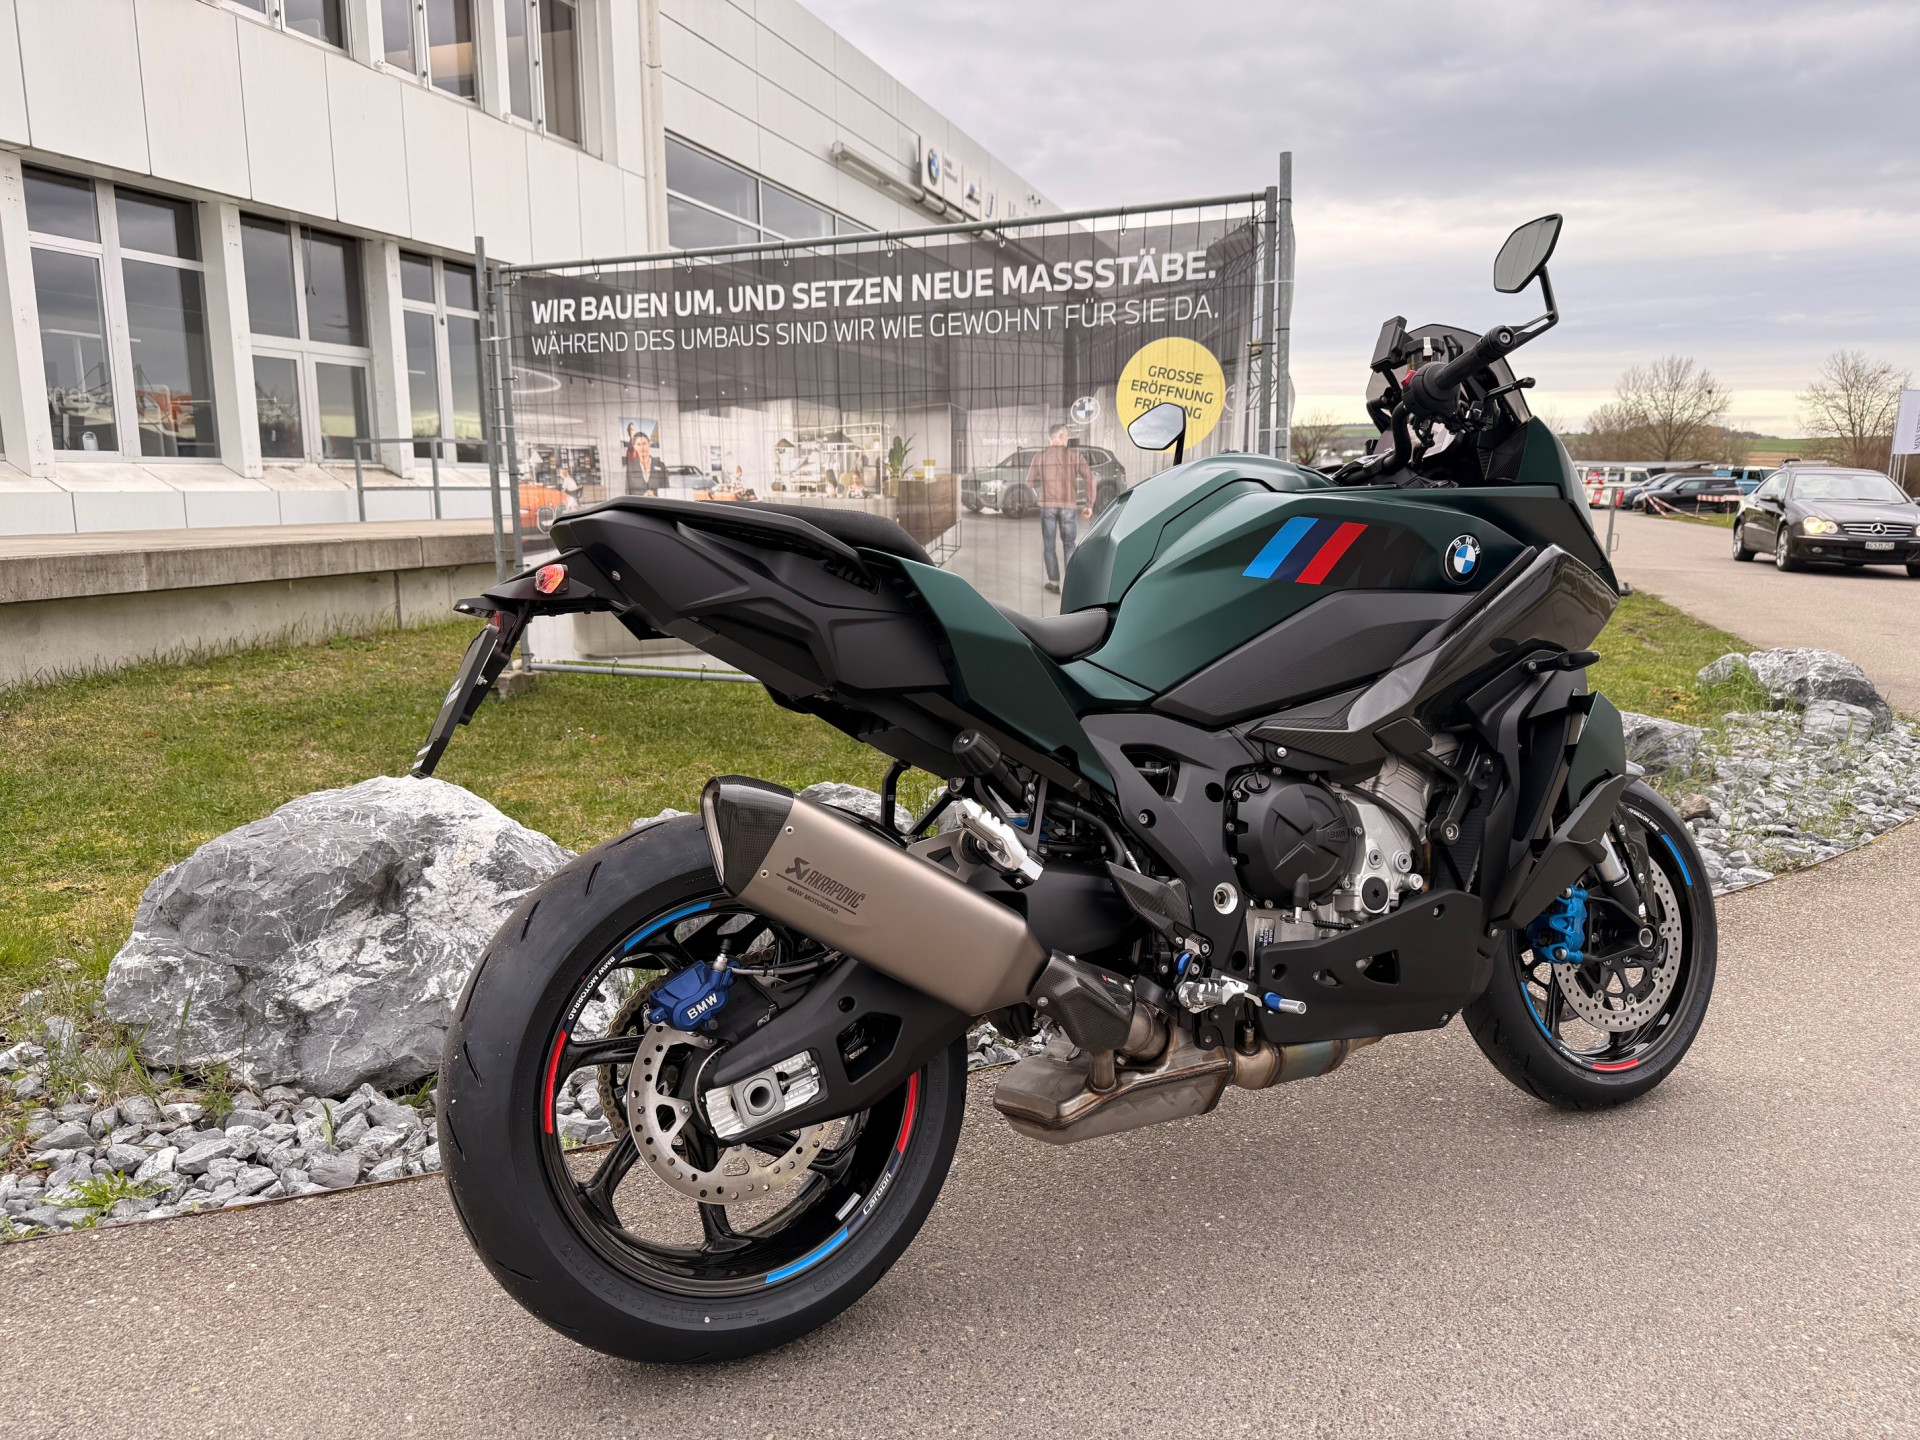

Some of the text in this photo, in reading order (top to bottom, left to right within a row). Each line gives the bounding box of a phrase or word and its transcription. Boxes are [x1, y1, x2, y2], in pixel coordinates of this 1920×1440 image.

[531, 247, 1216, 324] WIR BAUEN UM. UND SETZEN NEUE MASSSTÄBE.
[531, 294, 1219, 356] WÄHREND DES UMBAUS SIND WIR WIE GEWOHNT FÜR SIE DA.
[1148, 365, 1204, 385] GROSSE
[1130, 379, 1214, 404] ERÖFFNUNG
[1453, 536, 1481, 555] BMW
[786, 886, 804, 897] BMW
[803, 894, 838, 915] MOTORRAD
[568, 956, 616, 1020] BMW MOTORRAD
[686, 993, 718, 1020] BMW
[863, 1170, 892, 1215] Carbon
